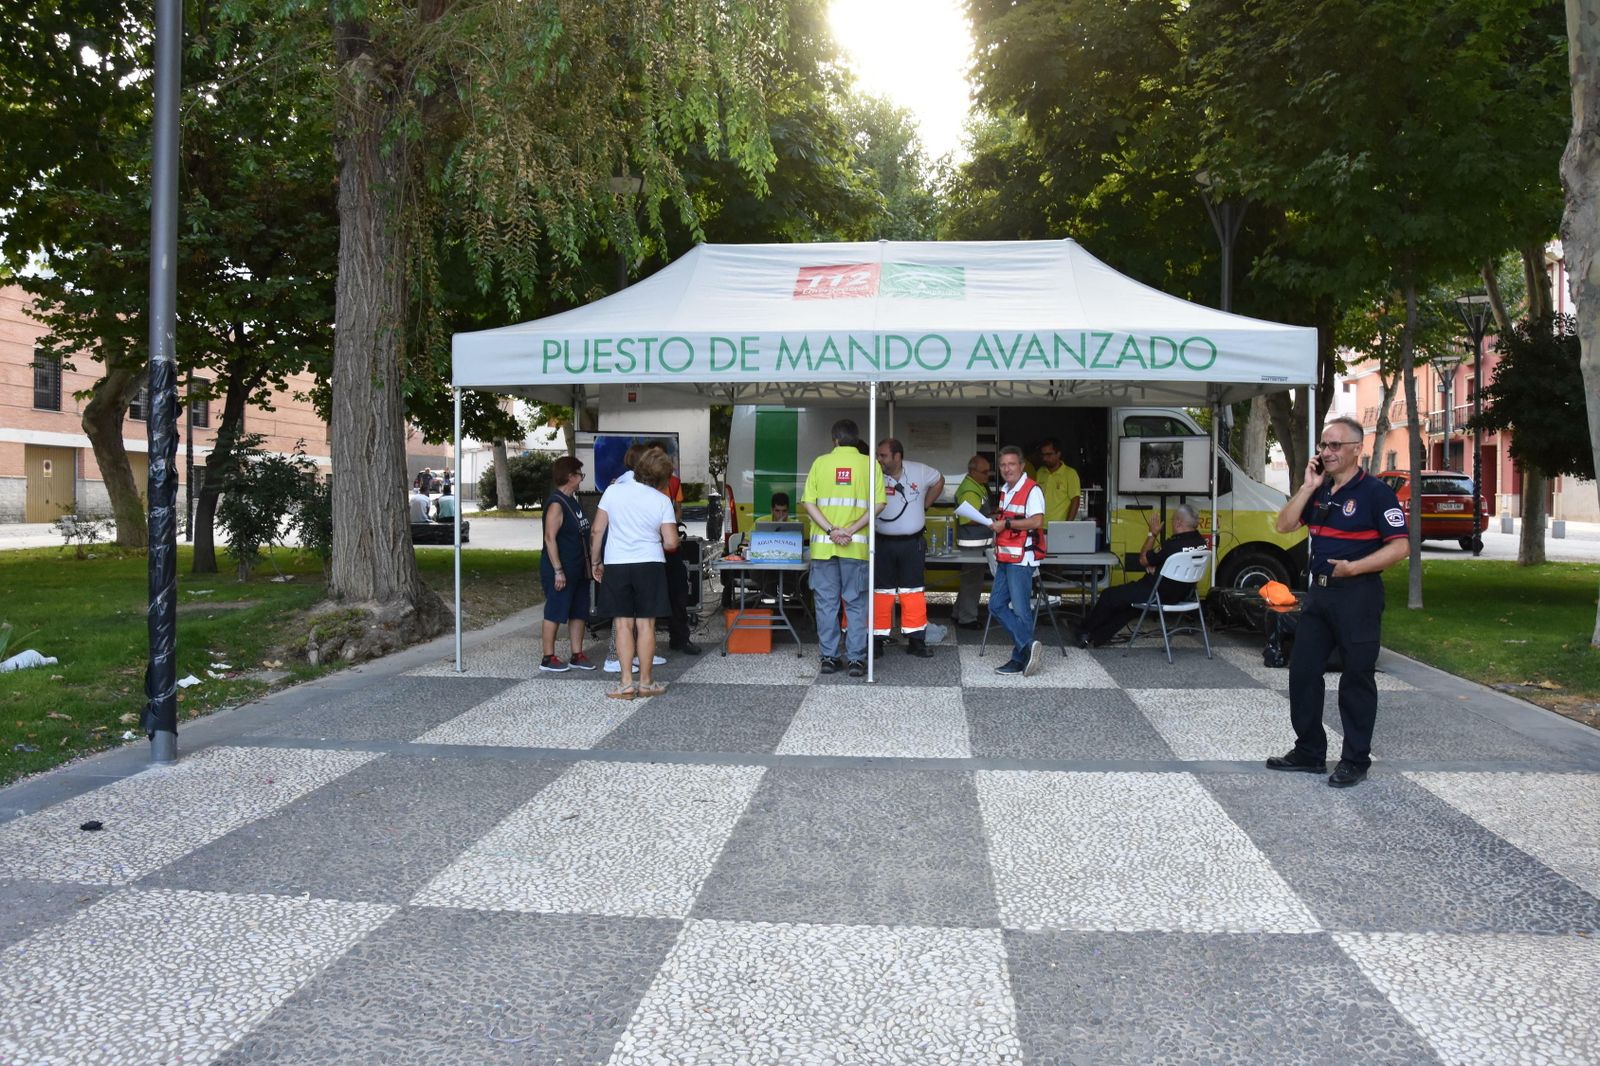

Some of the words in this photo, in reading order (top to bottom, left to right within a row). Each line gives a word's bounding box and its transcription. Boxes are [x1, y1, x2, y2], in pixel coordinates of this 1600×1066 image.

[806, 272, 871, 288] 112
[542, 336, 695, 374] PUESTO
[710, 336, 760, 371] DE
[776, 333, 951, 371] MANDO
[966, 332, 1217, 371] AVANZADO
